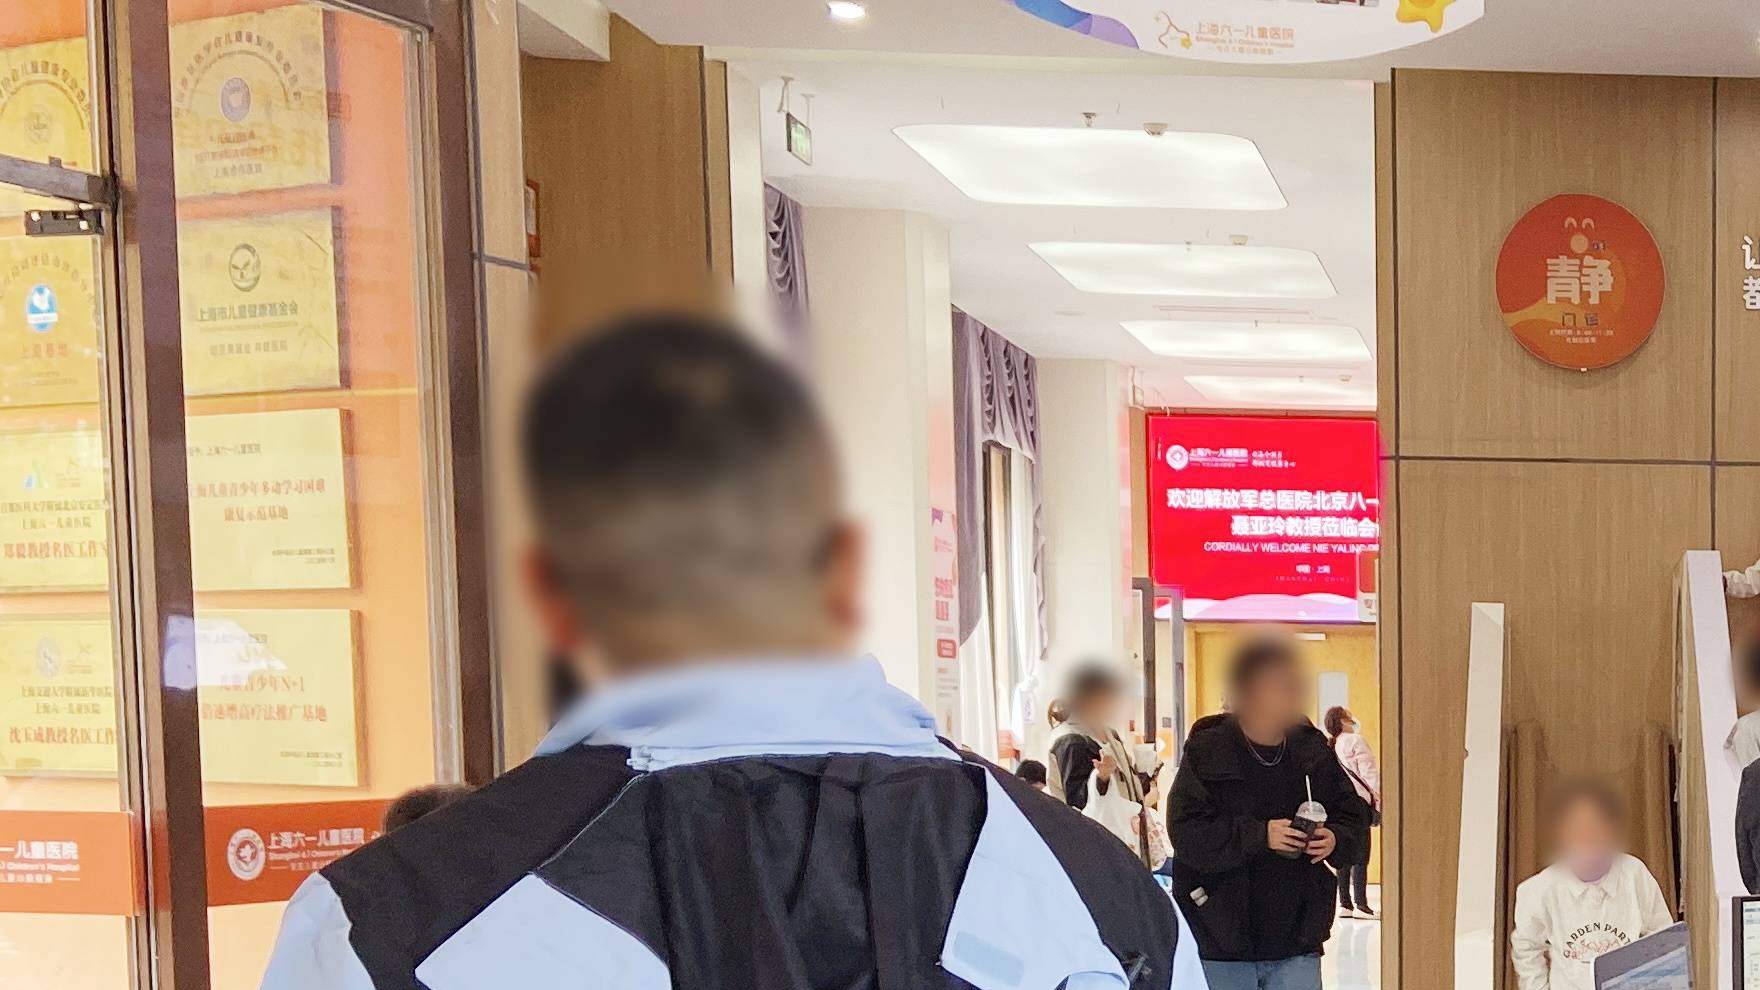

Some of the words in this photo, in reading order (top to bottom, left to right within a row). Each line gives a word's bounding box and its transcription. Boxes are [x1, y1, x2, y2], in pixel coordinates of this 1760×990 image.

[1196, 21, 1295, 40] 上海六一儿童医院
[1546, 255, 1615, 305] 静
[190, 478, 327, 499] 海儿童青少年多动学习困难
[1231, 515, 1379, 538] 聂亚玲教授莅临会
[1203, 541, 1259, 552] CORDIALLY
[1261, 543, 1311, 553] WELCOME
[1312, 544, 1329, 553] NIE
[268, 827, 366, 850] 上海六一儿童医院
